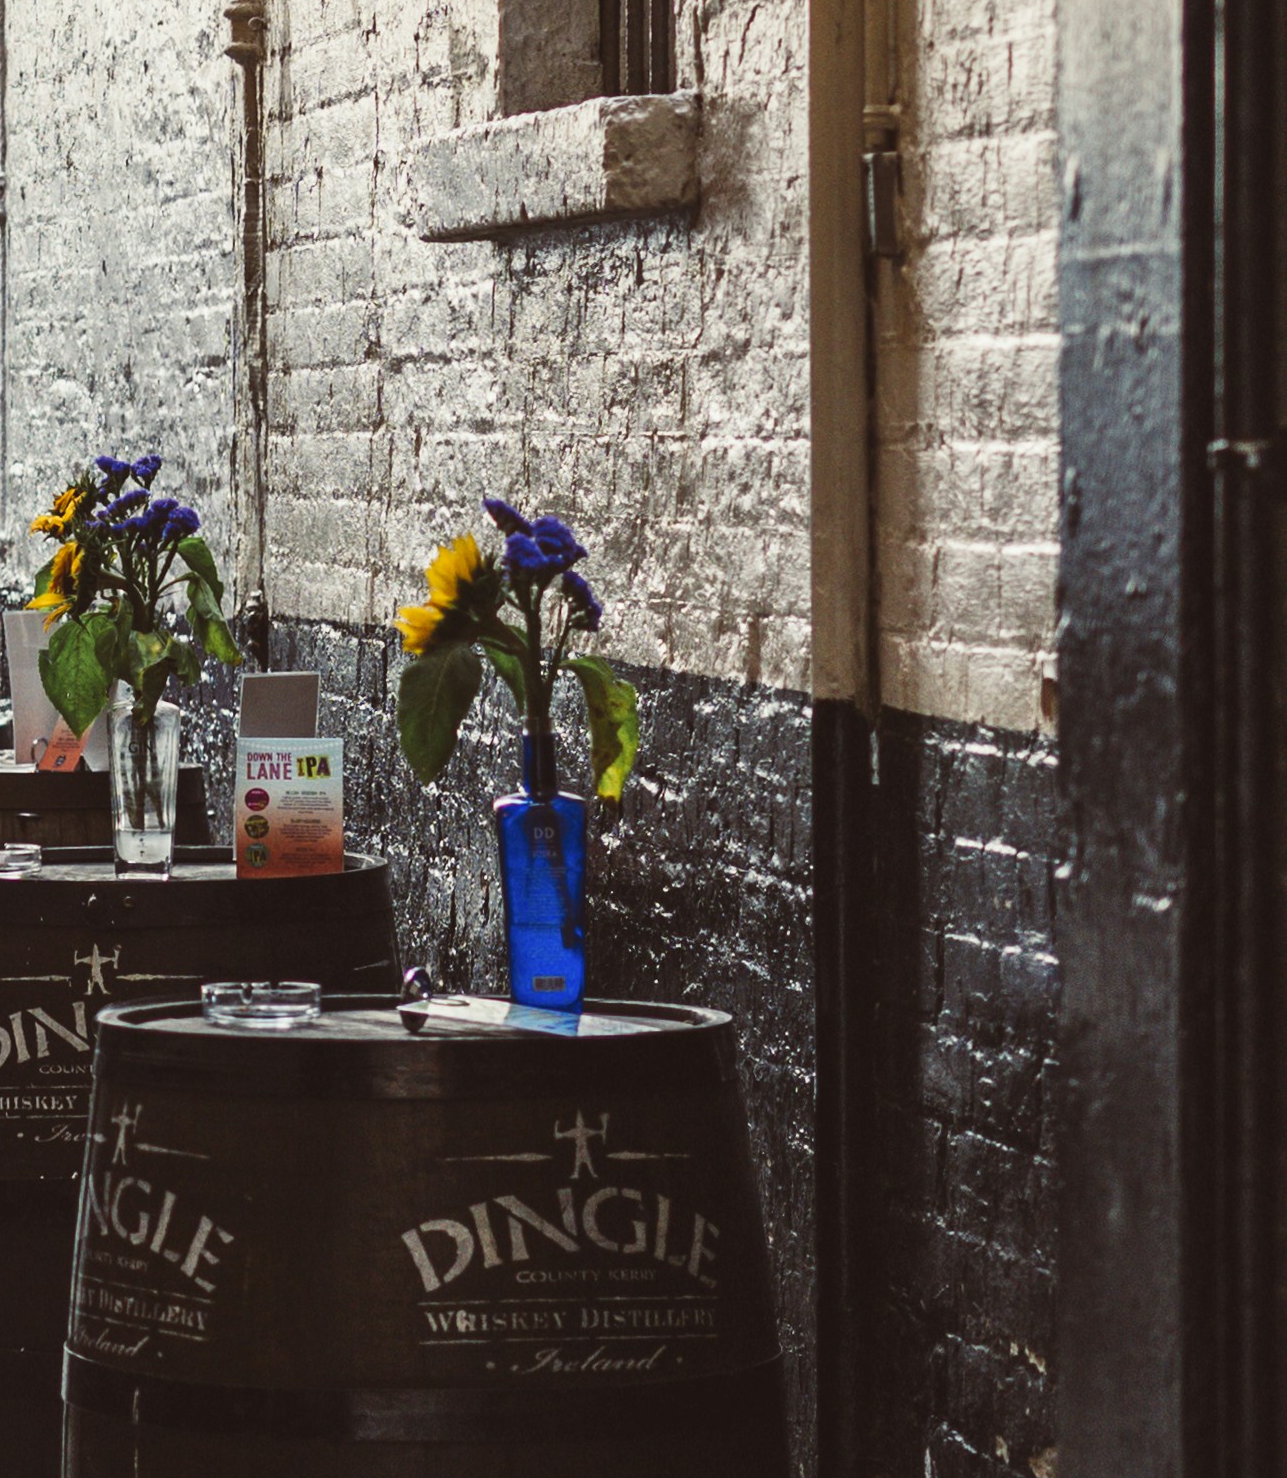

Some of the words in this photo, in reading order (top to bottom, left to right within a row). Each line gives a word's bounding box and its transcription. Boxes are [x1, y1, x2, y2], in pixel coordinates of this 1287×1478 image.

[247, 752, 272, 762] DOWN
[276, 752, 292, 762] THE
[247, 763, 292, 780] LANE
[296, 756, 331, 778] IPA
[533, 826, 554, 840] DD
[39, 1064, 94, 1075] COUNT
[85, 1171, 235, 1293] NGLE
[401, 1186, 720, 1293] DINGLE
[515, 1270, 601, 1284] COUNTY
[609, 1268, 657, 1281] KERRY
[424, 1309, 566, 1333] WHISKEY
[581, 1307, 715, 1330] DISTILLERY
[510, 1344, 667, 1374] Ireland
